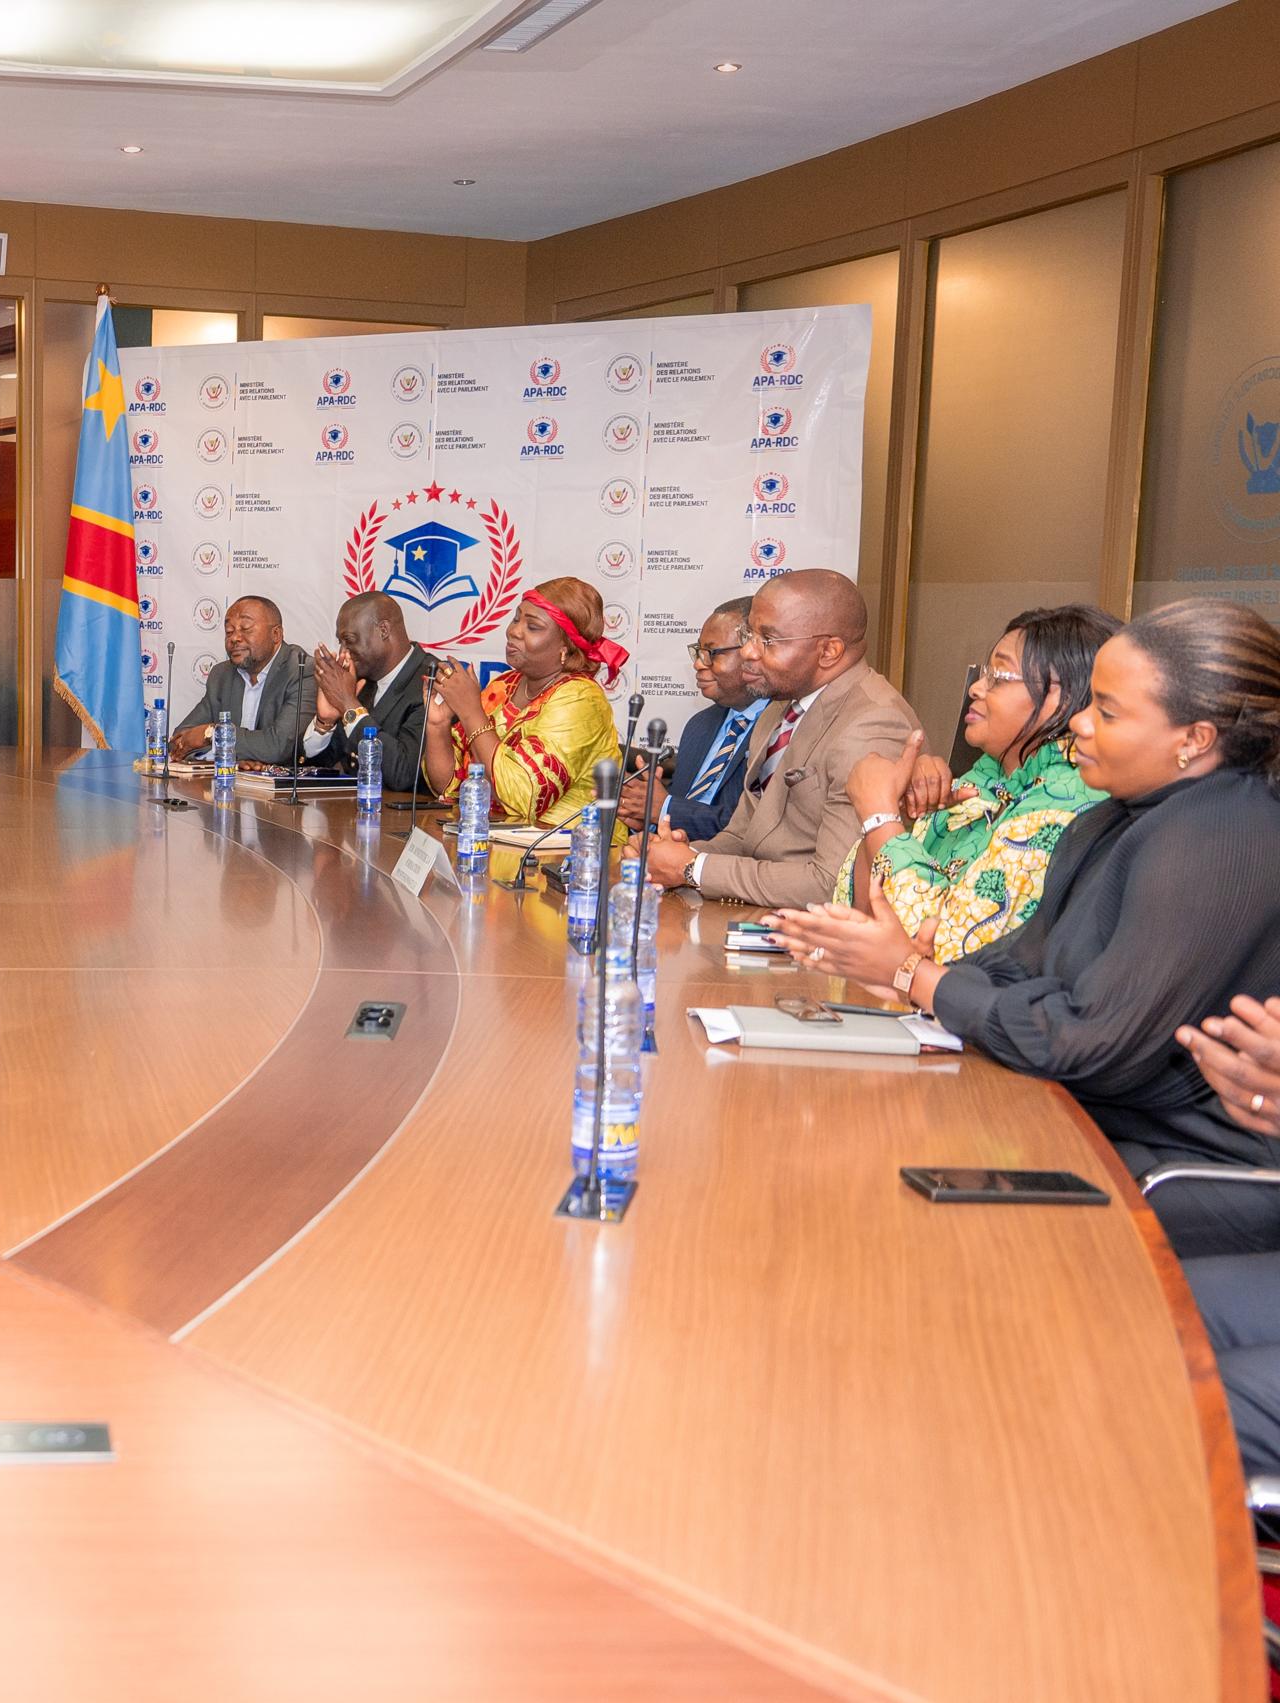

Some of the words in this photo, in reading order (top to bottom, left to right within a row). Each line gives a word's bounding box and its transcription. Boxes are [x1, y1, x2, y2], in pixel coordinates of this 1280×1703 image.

[753, 374, 803, 386] APA-RDC
[523, 386, 567, 398] APA-RDC
[317, 395, 356, 406] APA-RDC
[128, 402, 166, 412] APA-RDC
[750, 436, 799, 448] APA-RDC
[520, 444, 564, 456] APA-RDC
[129, 455, 163, 464] APA-RDC
[315, 450, 354, 461] APA-RDC
[746, 503, 796, 513] APA-RDC
[134, 510, 162, 520] PA-RDC
[136, 566, 163, 575] PA-RDC
[139, 621, 162, 630] A-RDC
[142, 675, 163, 684] -RDC
